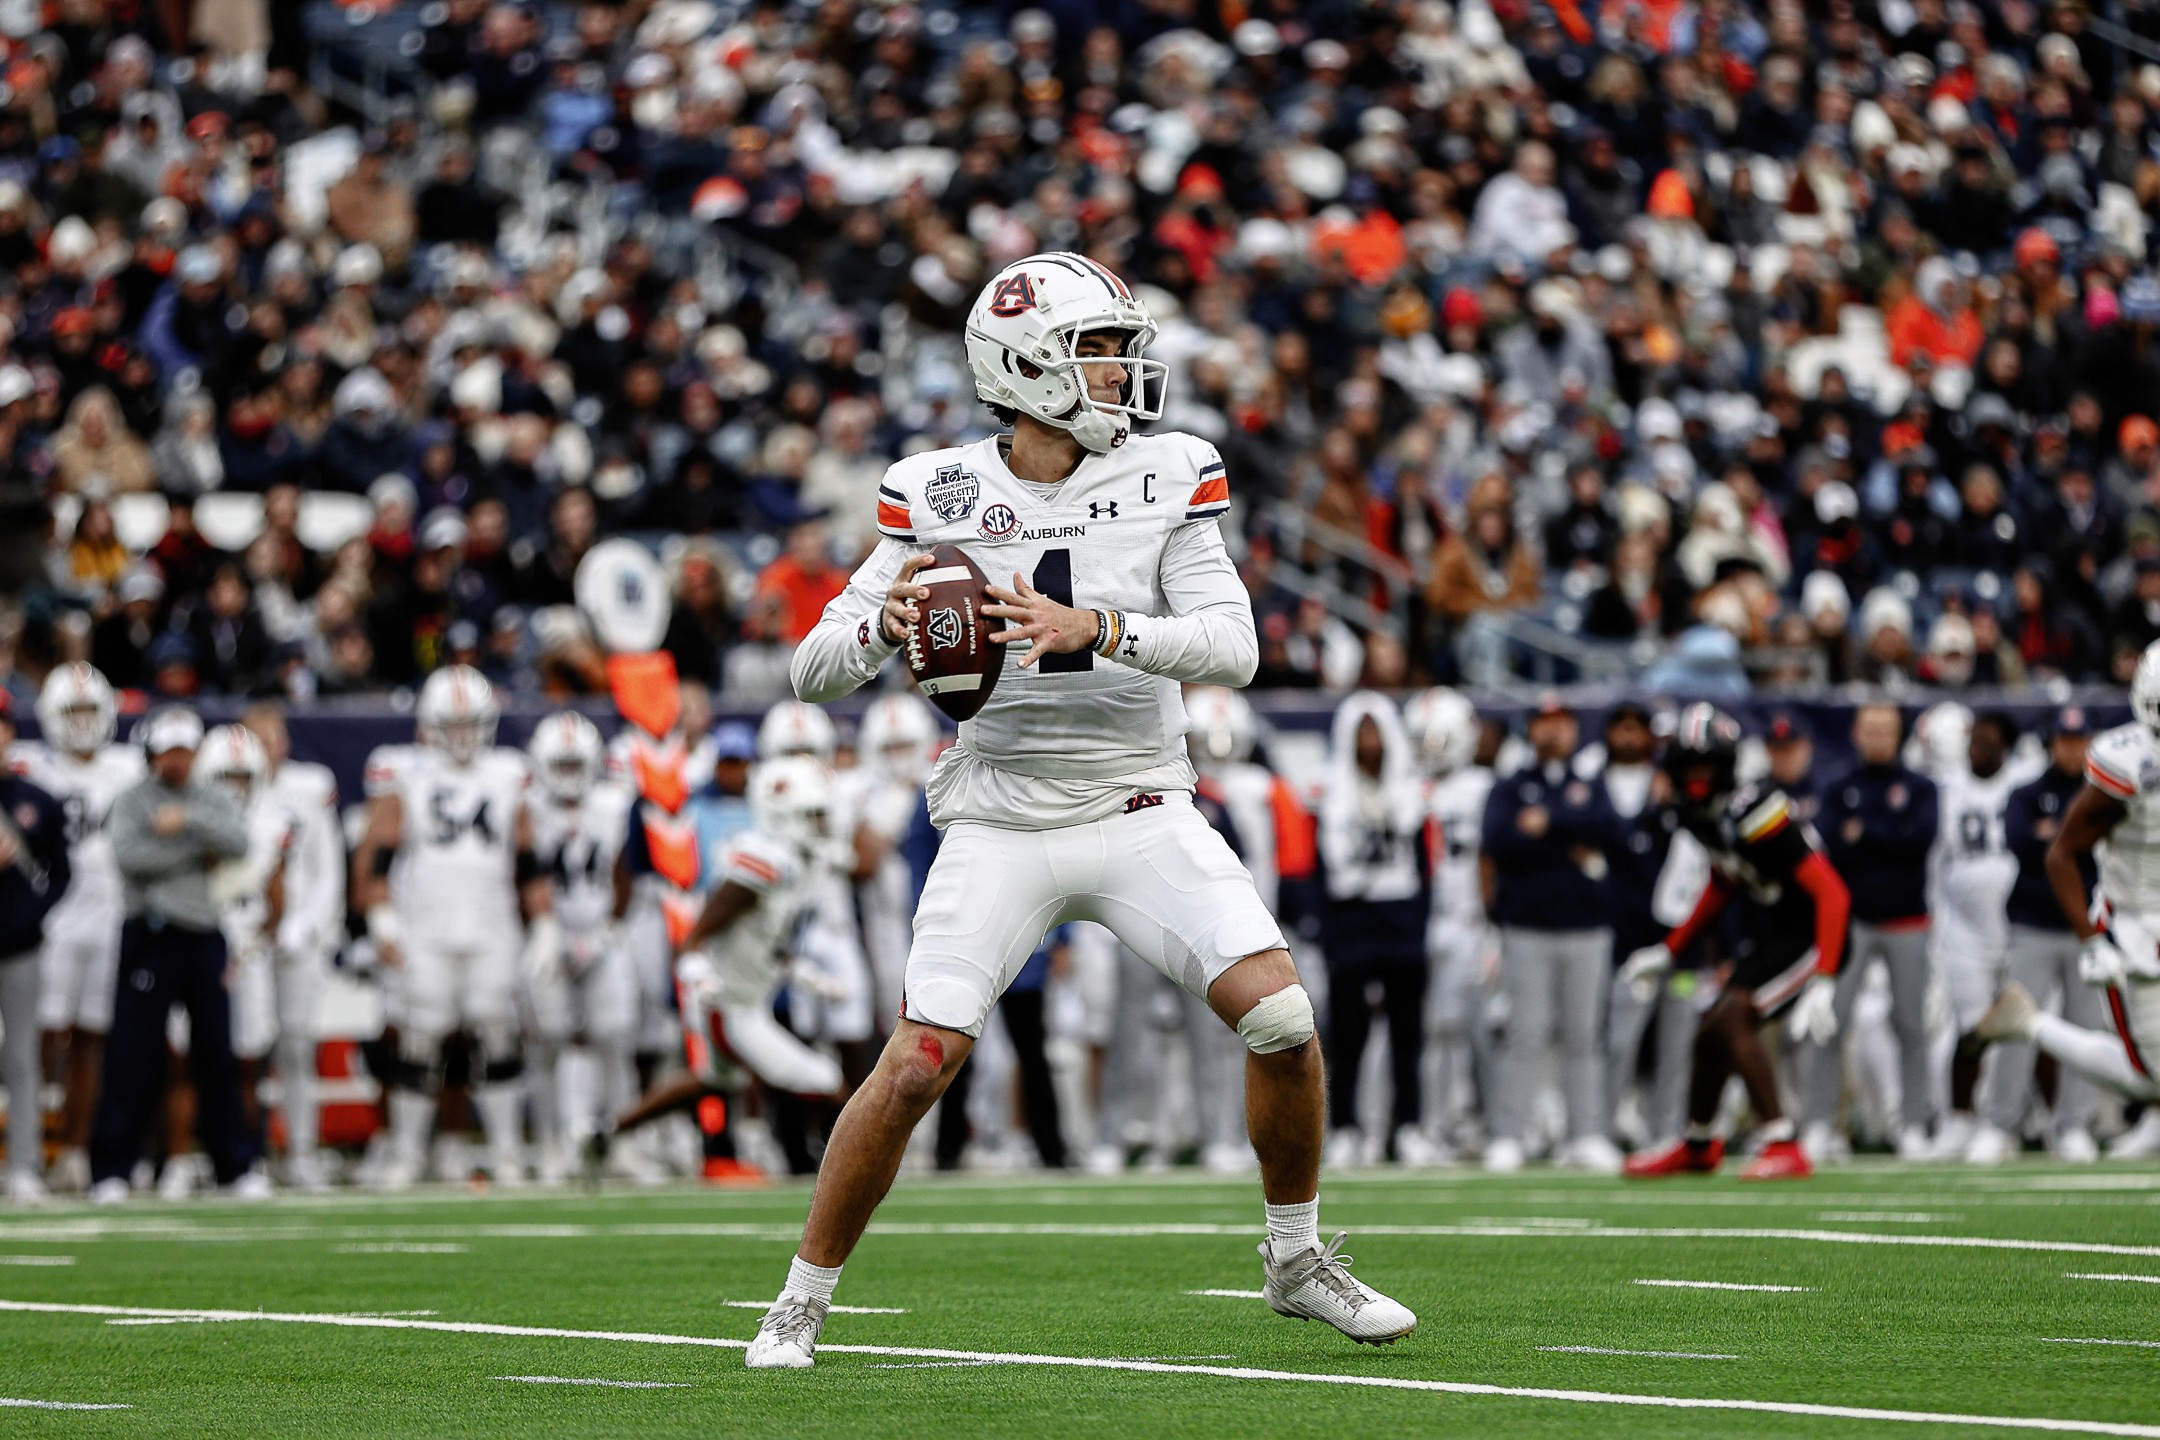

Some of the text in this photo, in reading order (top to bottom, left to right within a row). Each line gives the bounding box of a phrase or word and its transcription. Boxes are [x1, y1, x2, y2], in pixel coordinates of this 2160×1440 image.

[1053, 328, 1071, 359] UBURN
[929, 480, 974, 494] TRANSPERFECT
[930, 485, 976, 506] MUSIC CITY
[1143, 473, 1156, 504] C
[942, 497, 968, 509] BOWL
[984, 506, 1014, 533] SEC
[983, 527, 1018, 542] GRADUATE
[1021, 526, 1086, 541] AUBURN
[1032, 549, 1095, 674] 1
[428, 785, 500, 846] 54
